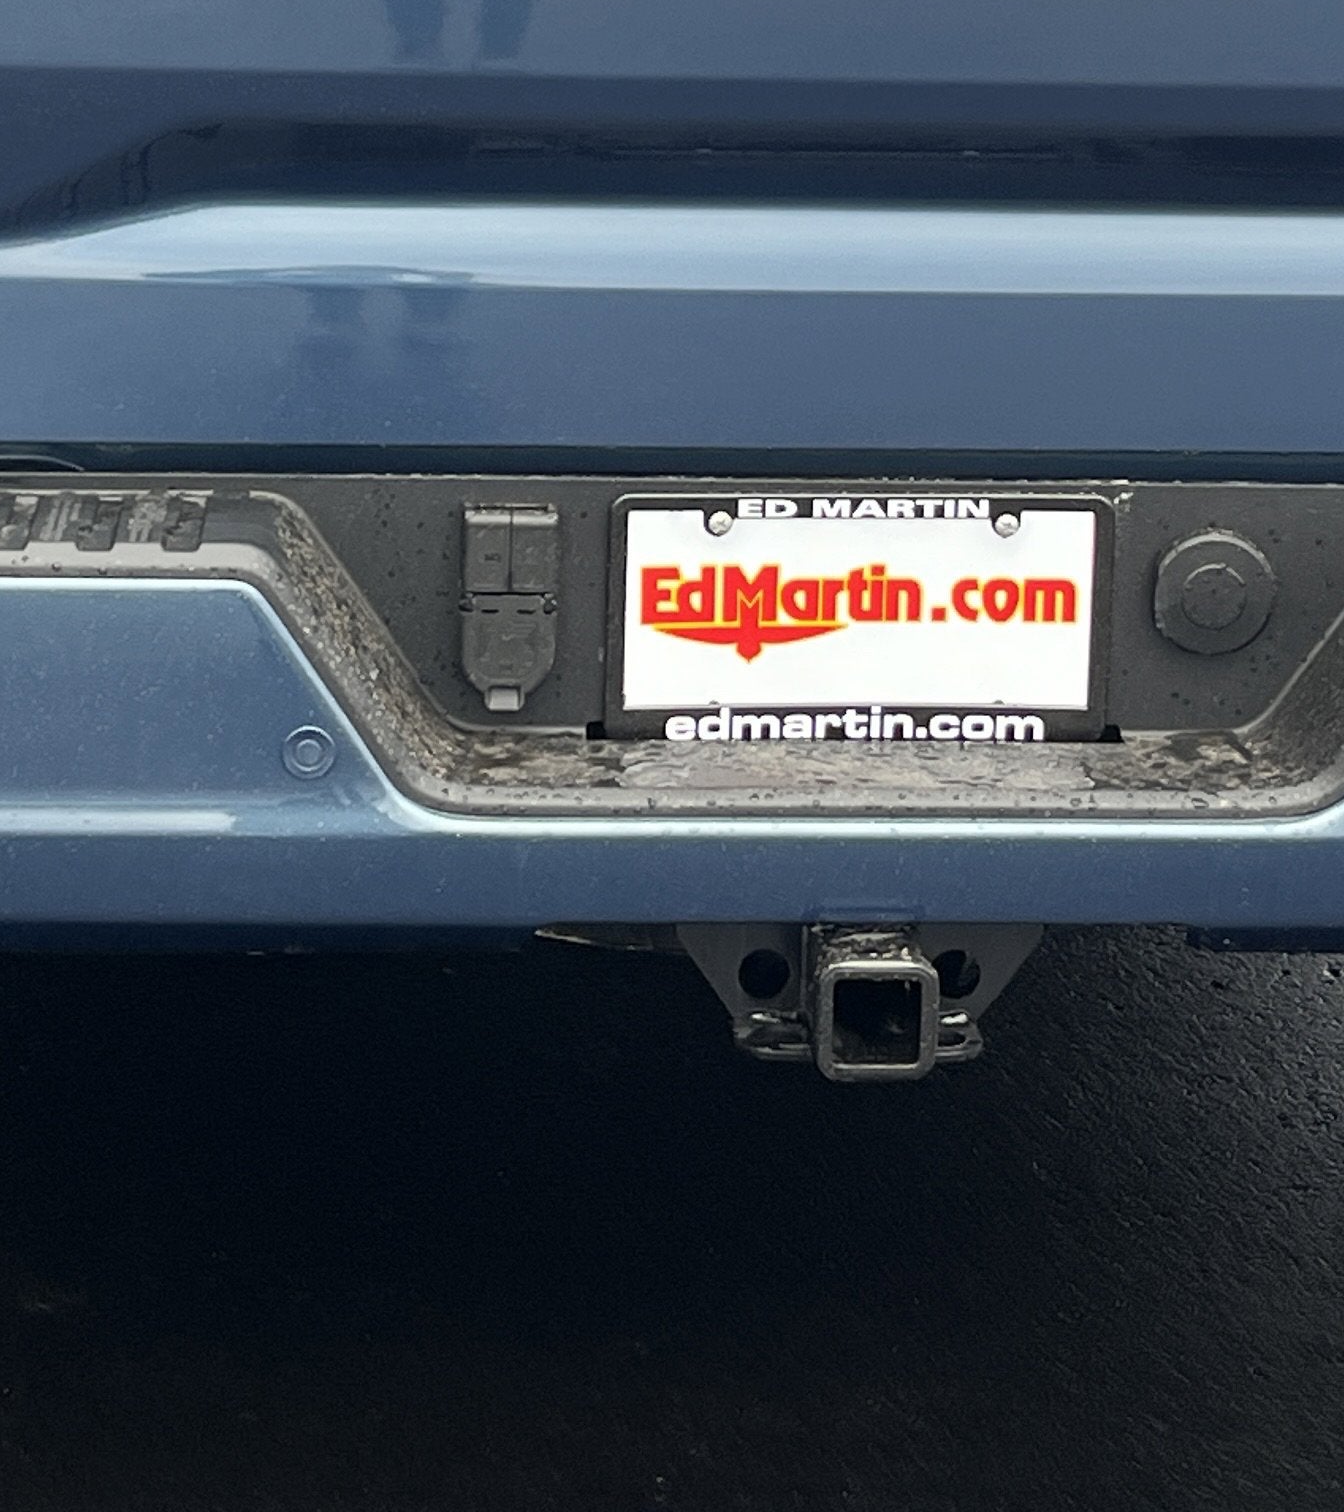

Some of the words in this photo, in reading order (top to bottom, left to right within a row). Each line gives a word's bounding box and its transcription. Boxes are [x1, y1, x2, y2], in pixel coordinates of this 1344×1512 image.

[736, 497, 799, 519] ED
[811, 497, 990, 520] MARTIN
[639, 563, 1077, 626] EdMartin.com
[664, 705, 1045, 742] edmartin.com
